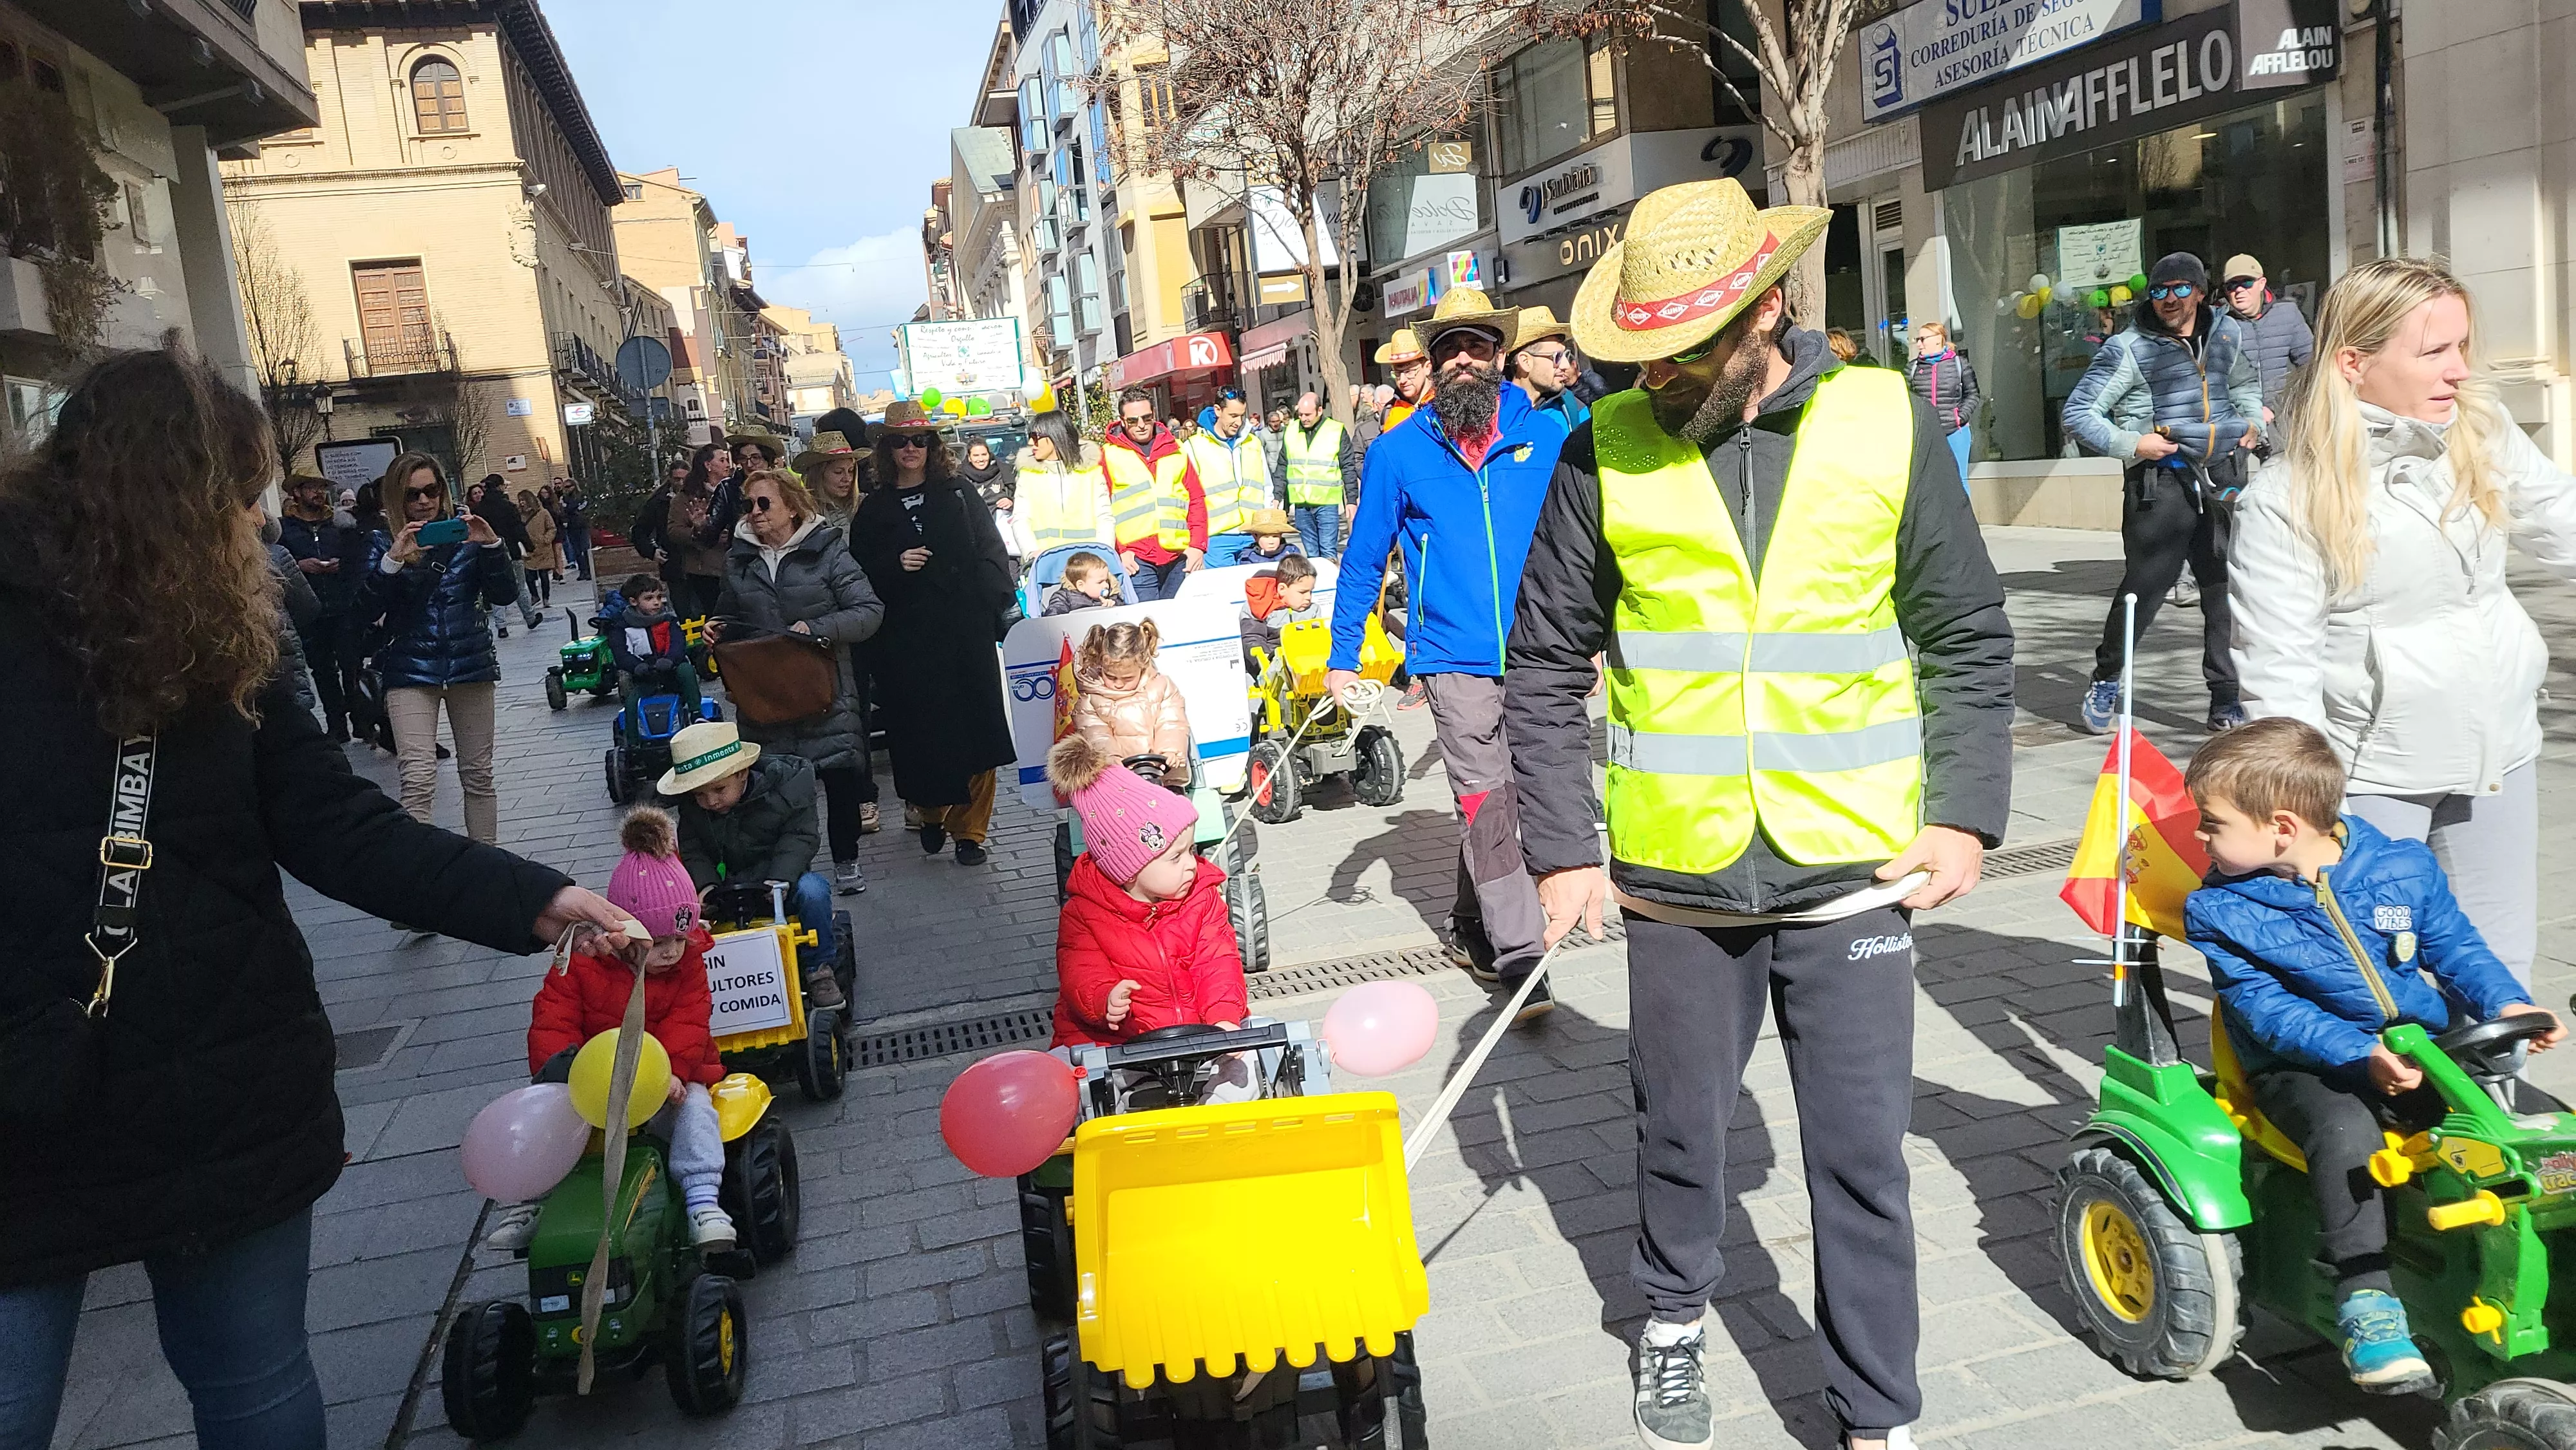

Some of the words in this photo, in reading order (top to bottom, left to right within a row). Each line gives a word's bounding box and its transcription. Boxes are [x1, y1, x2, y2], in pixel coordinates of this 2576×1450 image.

[1911, 13, 2006, 68] CORREDURÍA
[2014, 3, 2036, 28] DE
[2275, 26, 2333, 50] ALAIN
[1935, 40, 2011, 89] ASESORÍA
[2016, 12, 2094, 58] TÉCNICA
[2248, 48, 2334, 75] AFFLELOU
[921, 326, 945, 335] Respeto
[951, 335, 974, 344] Orgullo
[115, 751, 151, 849] BIMBA
[2376, 906, 2410, 918] GOOD
[2376, 918, 2411, 928] VIBES
[719, 993, 781, 1013] COMIDA
